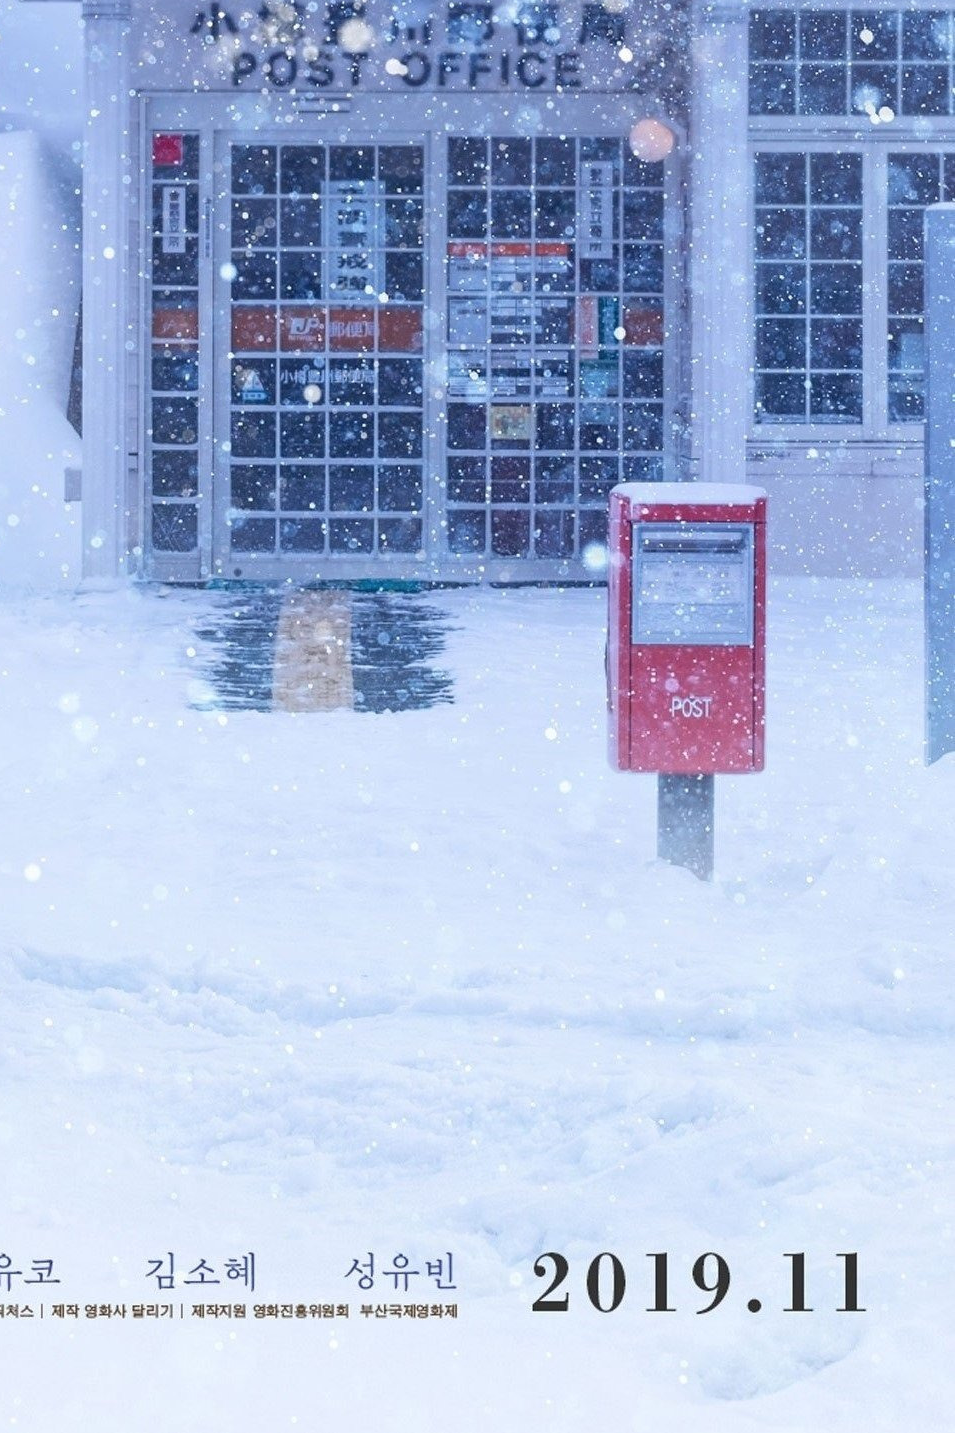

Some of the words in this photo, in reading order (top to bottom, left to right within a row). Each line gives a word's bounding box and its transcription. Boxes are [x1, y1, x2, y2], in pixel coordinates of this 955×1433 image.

[231, 51, 370, 88] POST
[400, 51, 583, 89] OFFICE
[670, 696, 713, 718] POST
